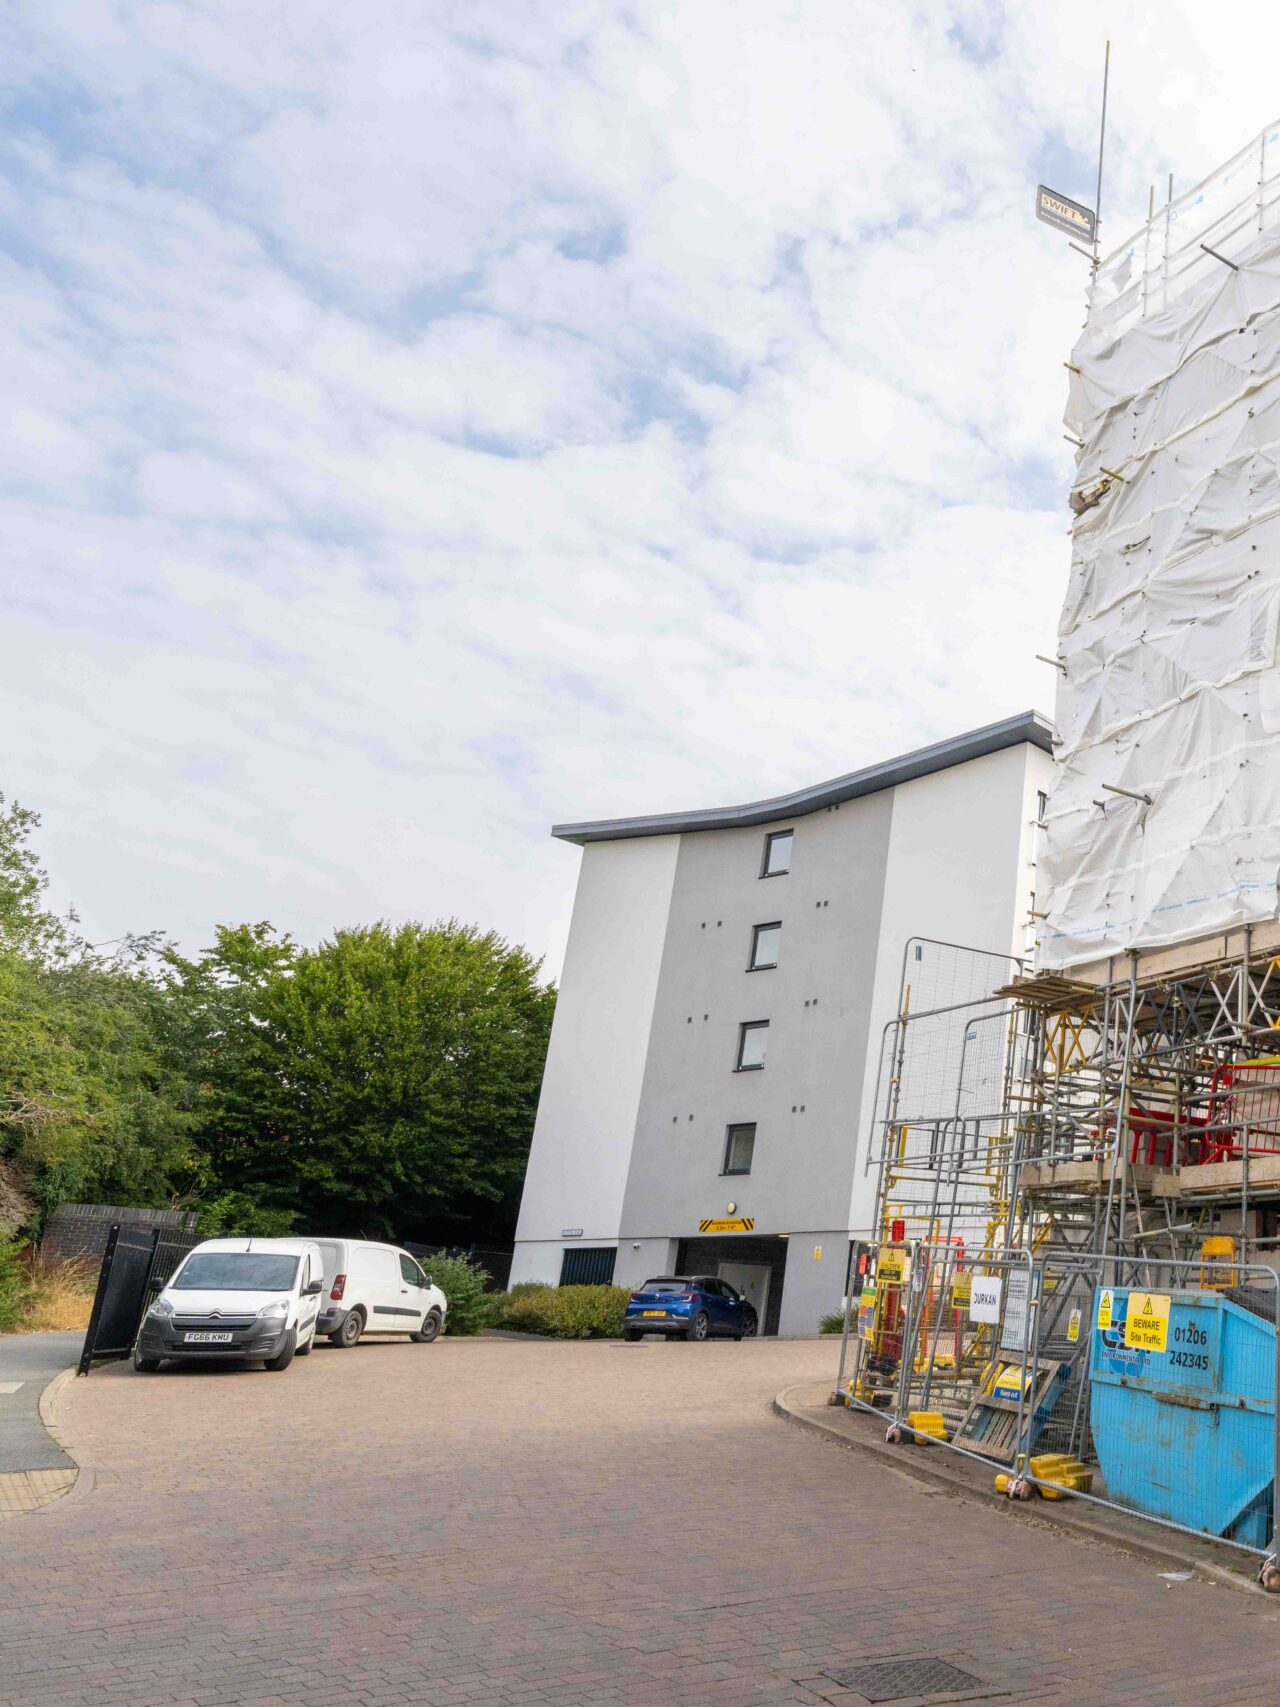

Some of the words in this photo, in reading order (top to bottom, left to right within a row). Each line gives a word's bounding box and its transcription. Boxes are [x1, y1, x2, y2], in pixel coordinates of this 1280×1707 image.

[1043, 196, 1077, 219] SWIFT
[1134, 1318, 1161, 1331] BEWARE
[1131, 1332, 1142, 1343] Site
[1143, 1334, 1162, 1345] Traffic
[1174, 1327, 1207, 1346] 01206
[1170, 1350, 1209, 1370] 242345
